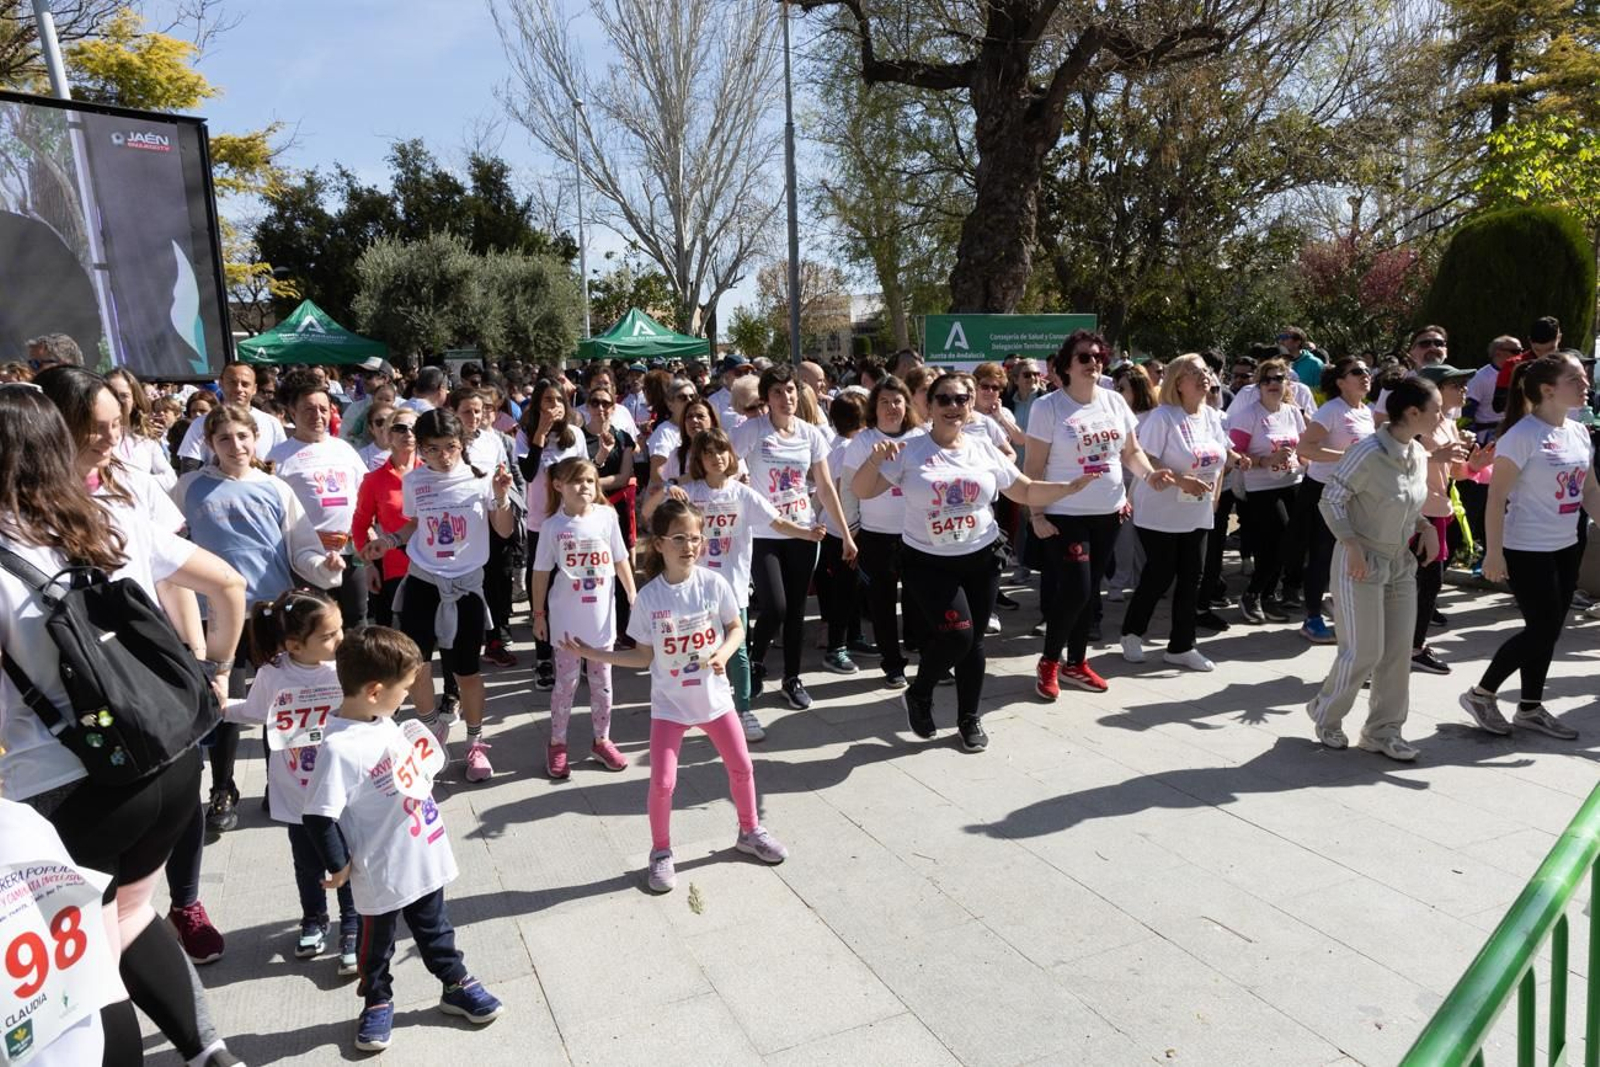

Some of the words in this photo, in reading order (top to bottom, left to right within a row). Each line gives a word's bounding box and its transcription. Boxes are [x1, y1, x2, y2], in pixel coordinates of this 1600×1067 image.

[127, 131, 169, 146] JAÉN
[1082, 428, 1120, 447] 5196
[705, 513, 738, 528] 767
[932, 514, 976, 535] 5479
[566, 550, 610, 568] 5780
[663, 627, 716, 655] 5799
[5, 904, 88, 999] 98
[4, 992, 48, 1029] CLAUDIA
